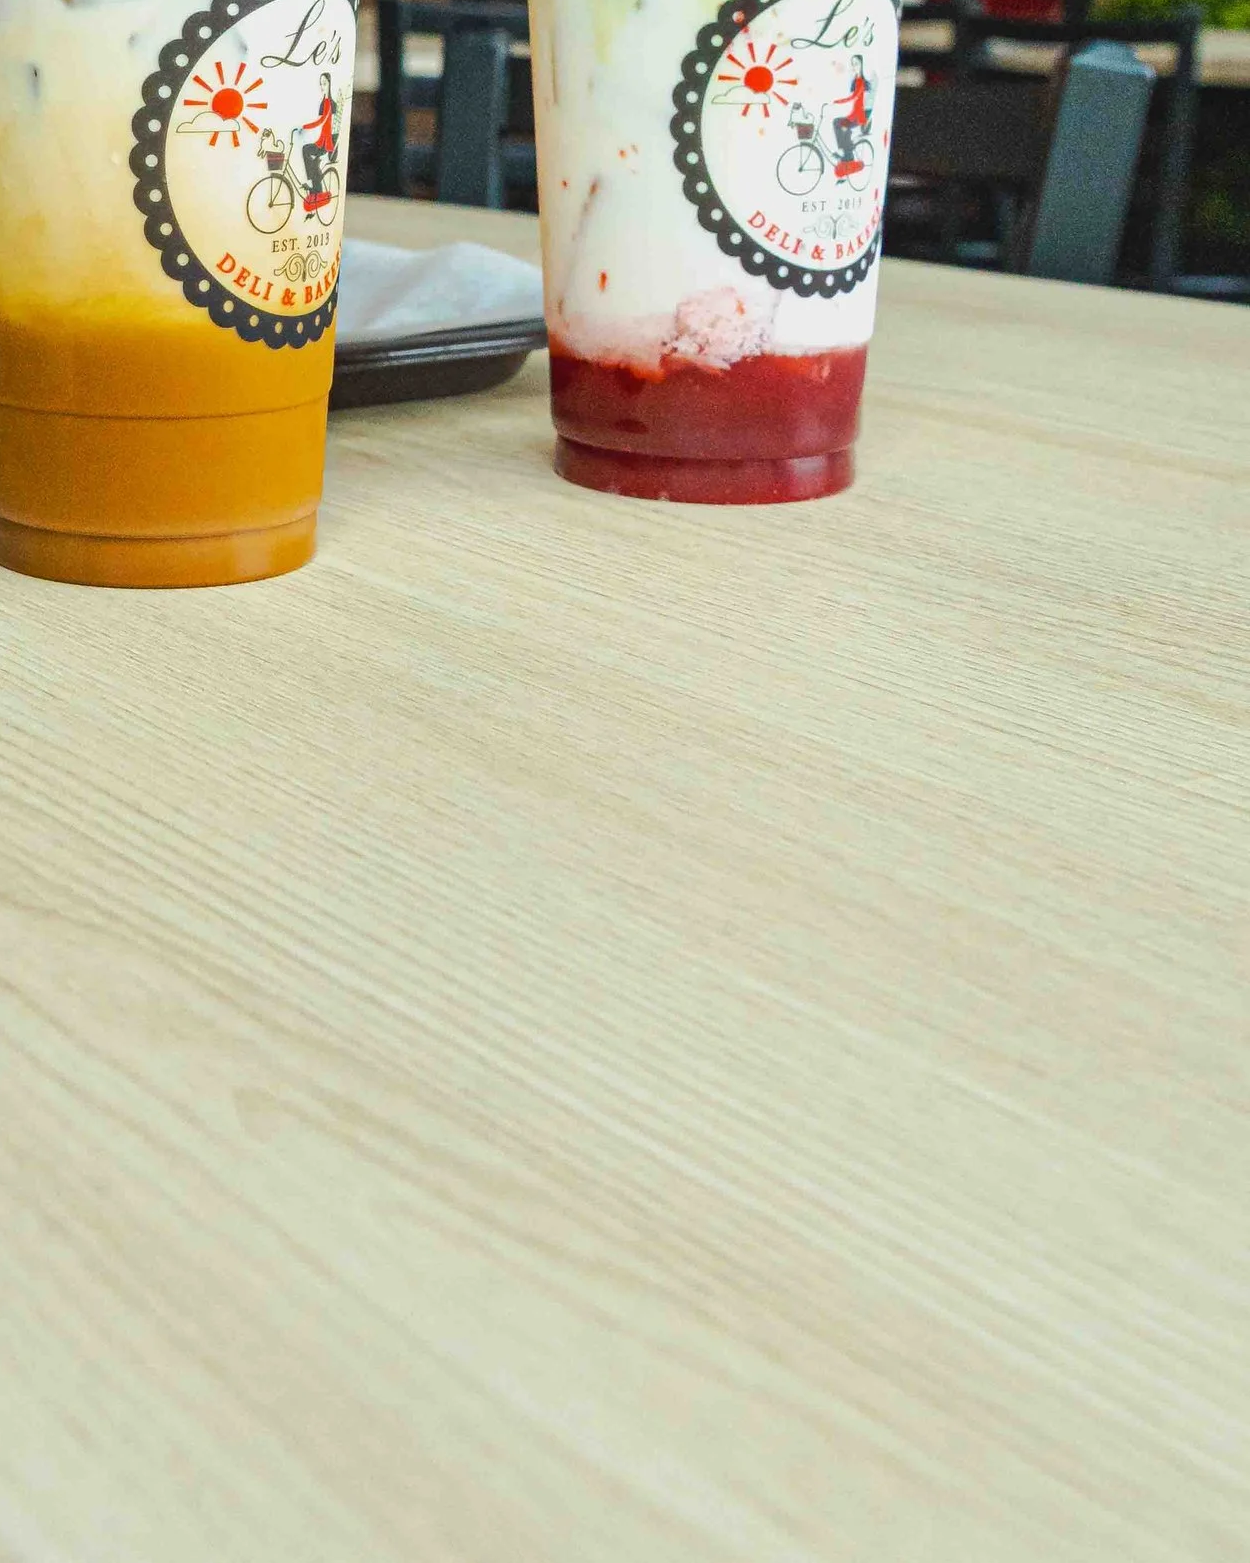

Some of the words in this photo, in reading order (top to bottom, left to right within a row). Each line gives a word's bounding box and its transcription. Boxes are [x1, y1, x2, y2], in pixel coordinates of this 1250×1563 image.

[272, 238, 300, 253] EST.
[307, 232, 330, 249] 2013
[747, 210, 802, 256] DELI
[811, 245, 825, 261] &
[216, 252, 273, 307] DELI
[281, 287, 296, 307] &
